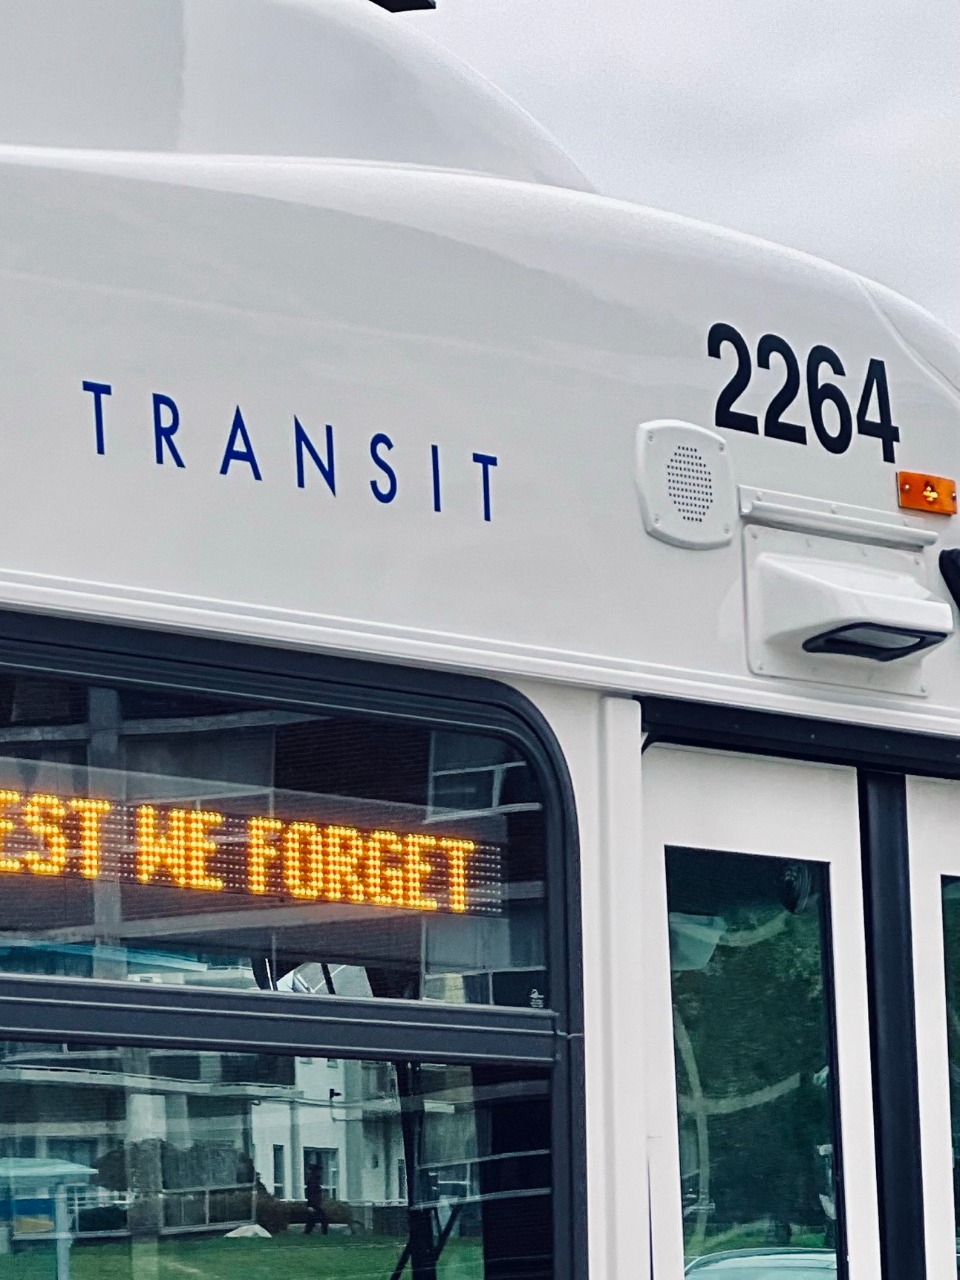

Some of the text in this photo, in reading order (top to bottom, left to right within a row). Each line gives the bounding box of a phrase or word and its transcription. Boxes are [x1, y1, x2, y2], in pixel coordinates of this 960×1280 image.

[82, 380, 498, 522] TRANSIT
[707, 322, 900, 464] 2264
[135, 805, 224, 891] WE
[246, 816, 476, 913] FORGET
